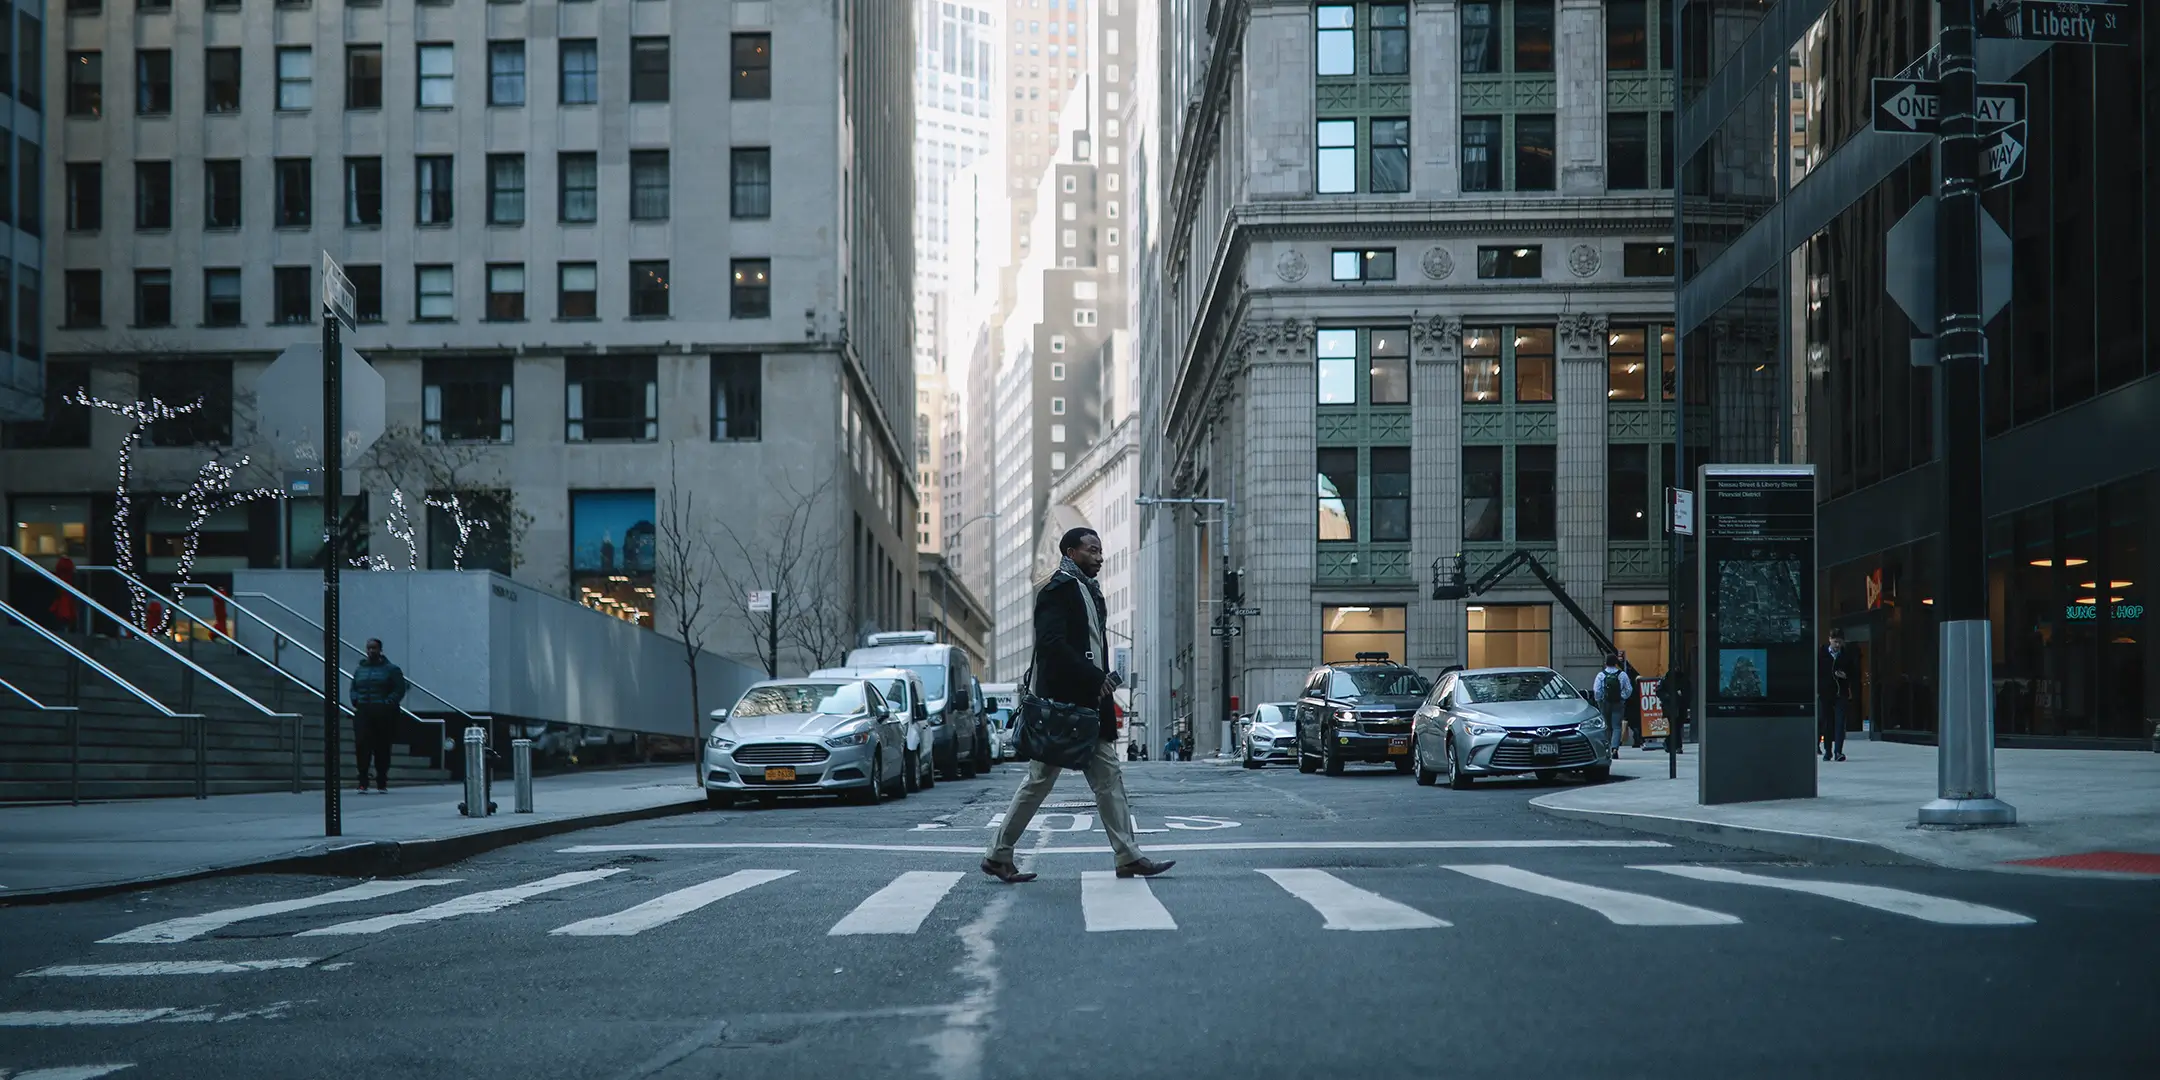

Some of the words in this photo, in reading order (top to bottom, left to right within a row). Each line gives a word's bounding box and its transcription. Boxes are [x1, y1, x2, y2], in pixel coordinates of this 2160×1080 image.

[2031, 8, 2096, 42] Liberty
[2105, 12, 2117, 29] St
[1897, 97, 1940, 117] ONE
[1977, 101, 2006, 120] AY
[1988, 142, 2016, 171] WAY
[2066, 605, 2097, 619] RUNC
[1641, 696, 1662, 711] OPE
